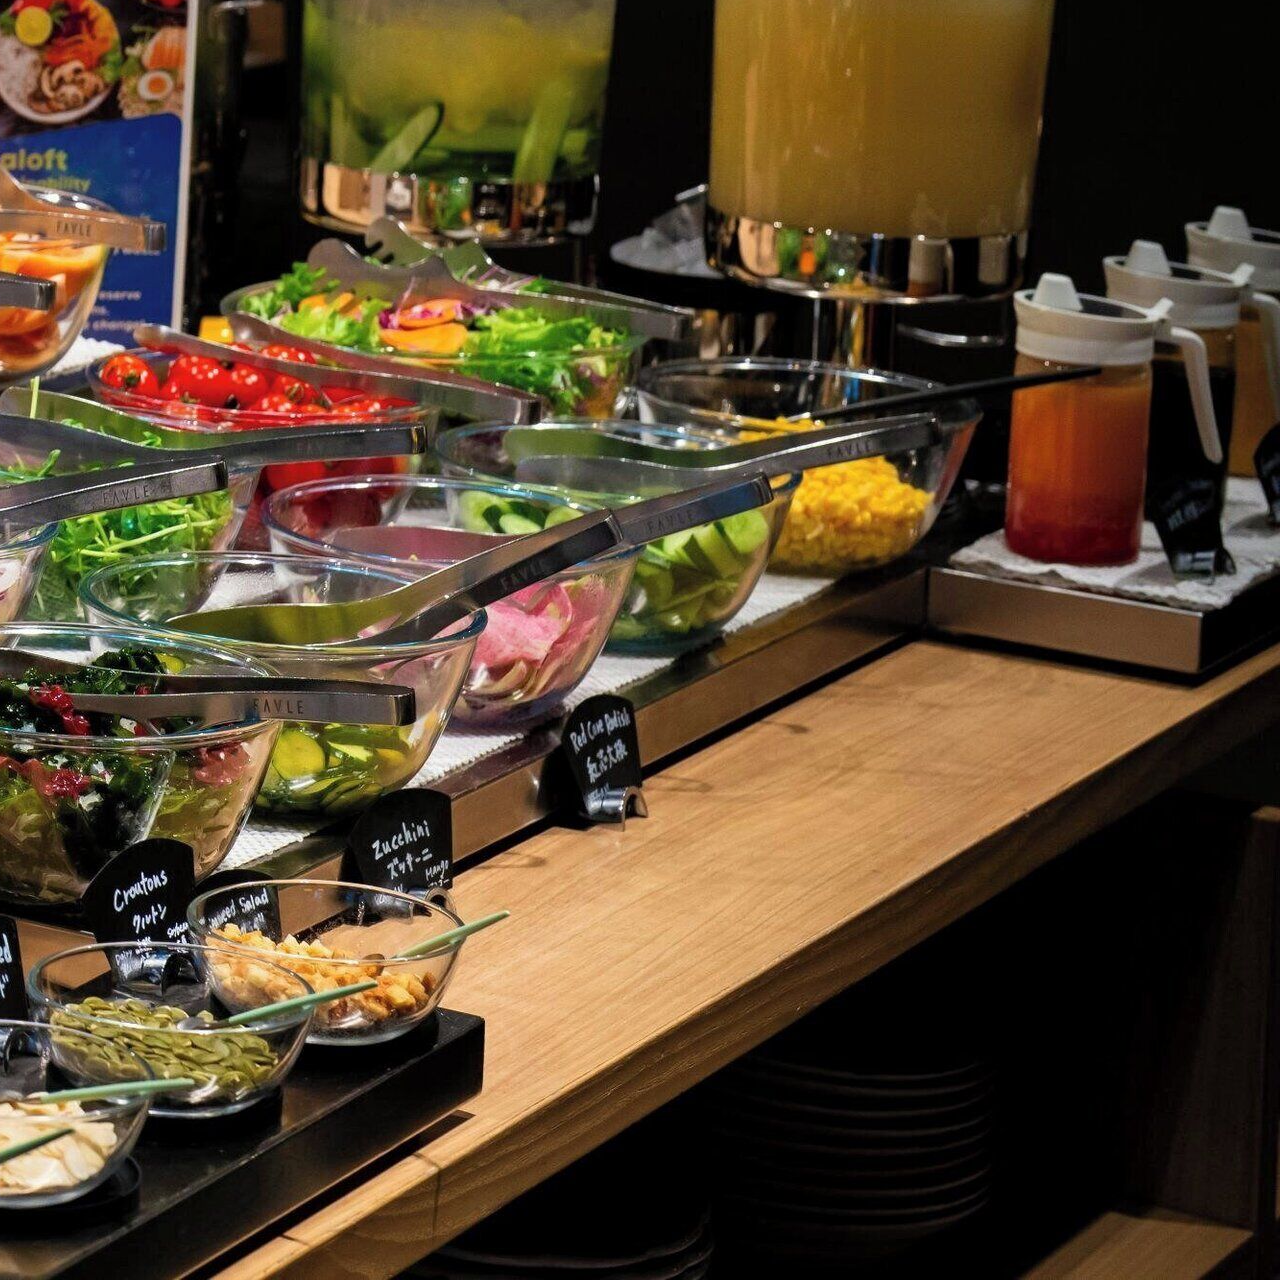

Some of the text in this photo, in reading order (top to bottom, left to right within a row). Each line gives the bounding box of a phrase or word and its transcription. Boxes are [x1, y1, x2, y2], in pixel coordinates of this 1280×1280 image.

[0, 148, 68, 170] aloft
[253, 698, 304, 714] FAVLE
[570, 722, 588, 754] Red
[372, 820, 430, 860] Zucchini
[387, 848, 433, 880] ズッキーニ
[425, 860, 449, 881] Mango
[113, 870, 168, 912] Croutons
[239, 887, 269, 913] Salad
[132, 903, 167, 934] クルトン
